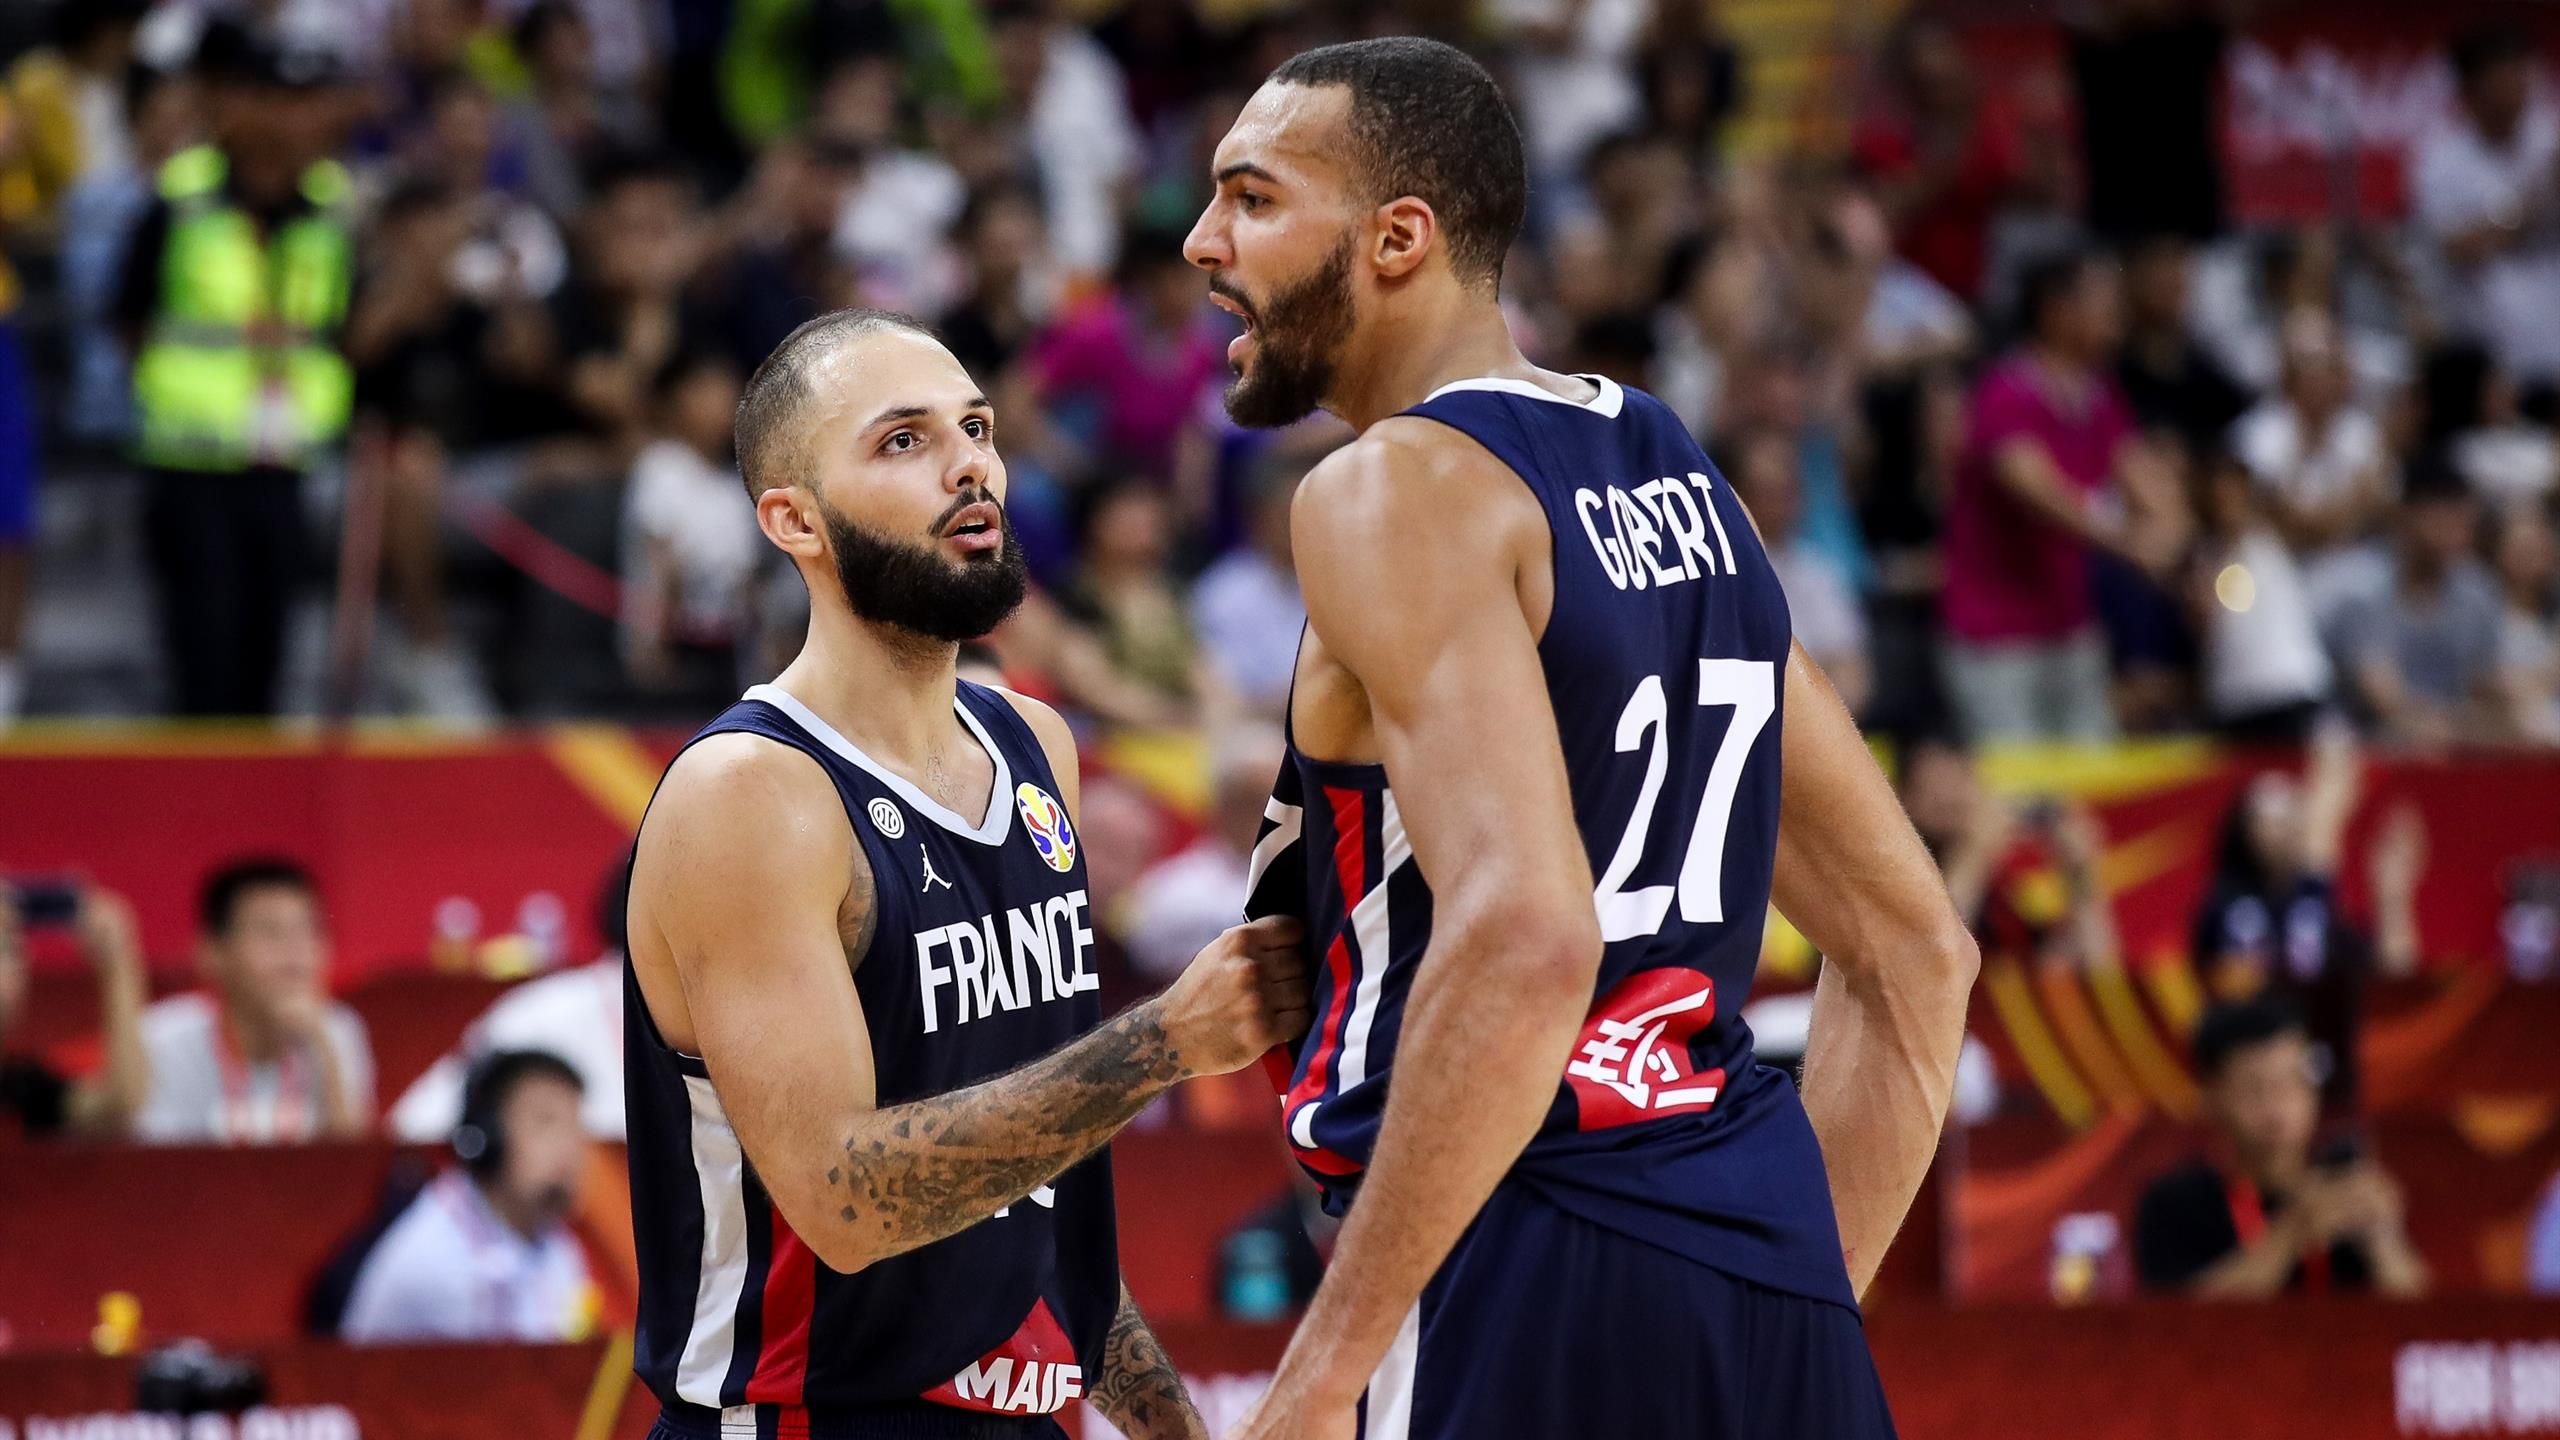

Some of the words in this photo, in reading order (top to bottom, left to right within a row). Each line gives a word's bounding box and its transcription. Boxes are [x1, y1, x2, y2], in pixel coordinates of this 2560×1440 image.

[1575, 472, 1737, 591] GOBERT
[1593, 658, 1776, 943] 27
[914, 889, 1100, 1034] FRANCE
[954, 1357, 1083, 1414] MAIF
